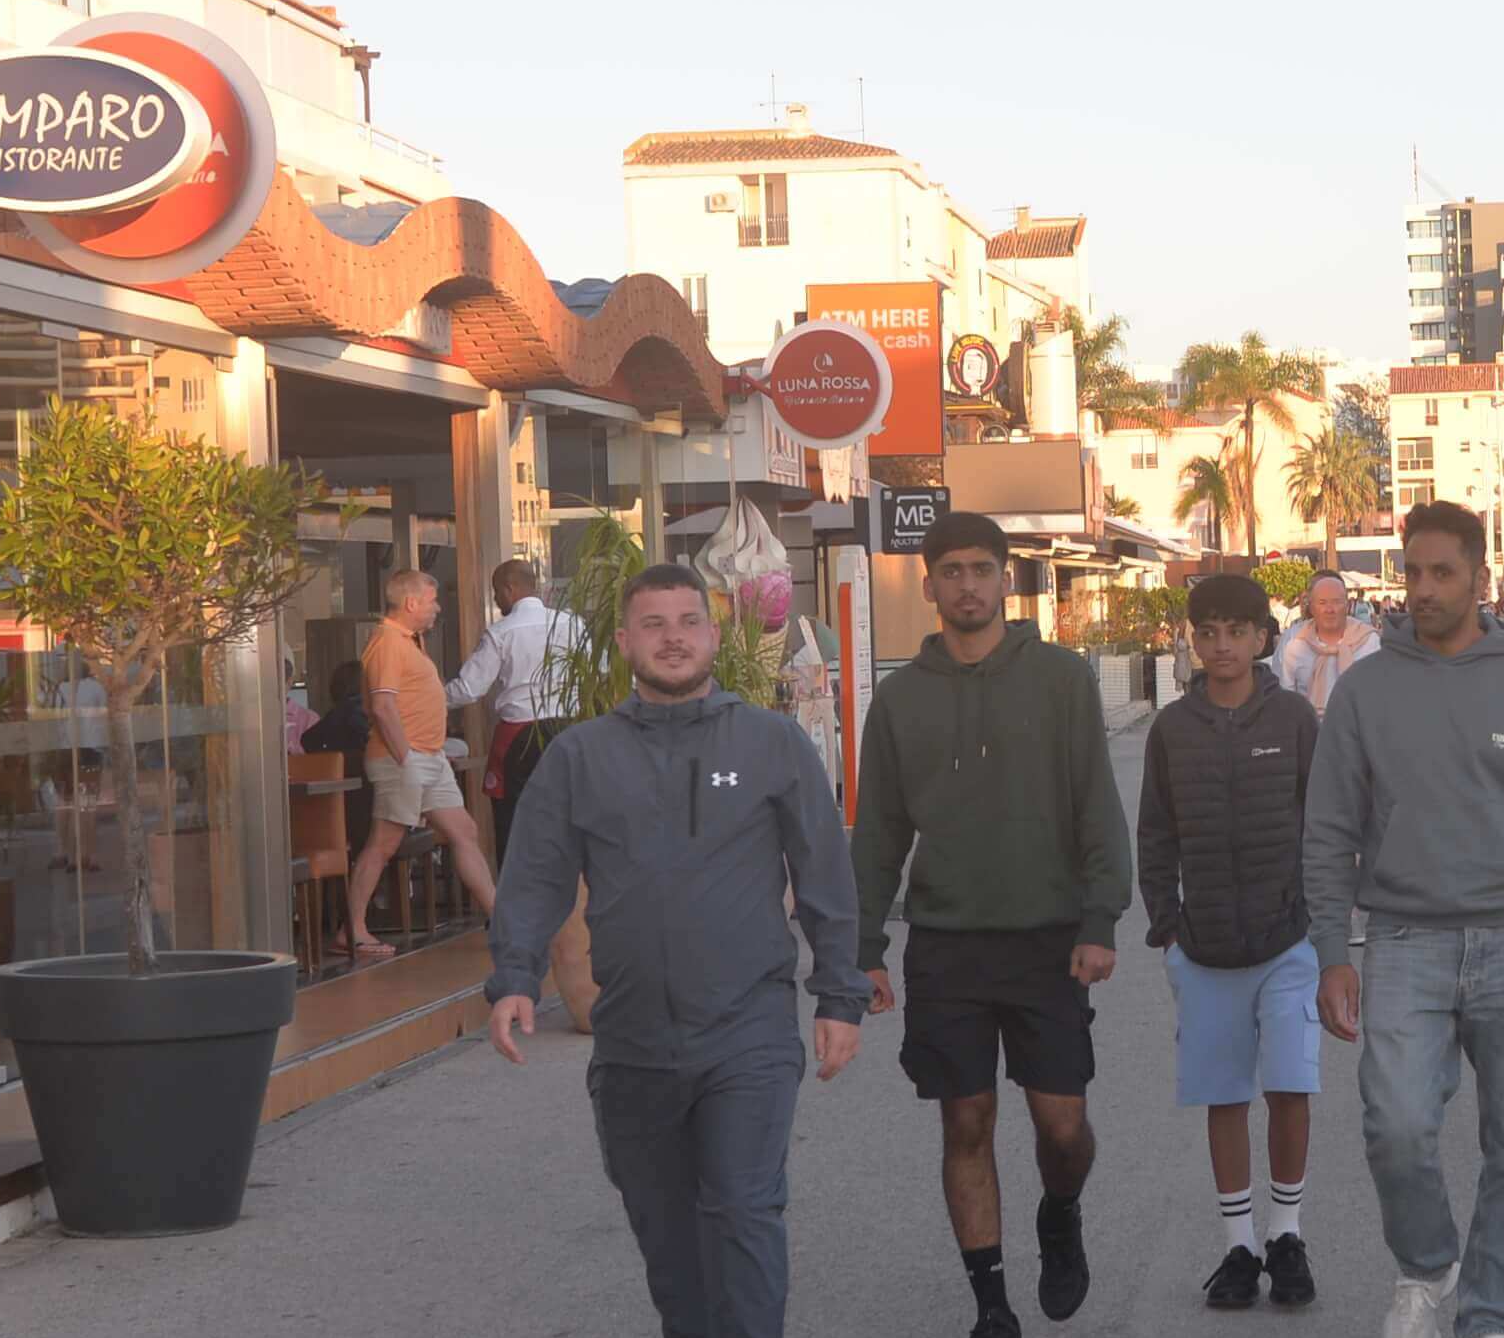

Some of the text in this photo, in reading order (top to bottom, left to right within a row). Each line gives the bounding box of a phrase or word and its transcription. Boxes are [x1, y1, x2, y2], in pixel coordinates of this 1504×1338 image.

[819, 309, 930, 329] ATM HERE
[883, 332, 931, 349] cash
[777, 376, 871, 393] LUNA ROSSA
[895, 505, 936, 526] MB
